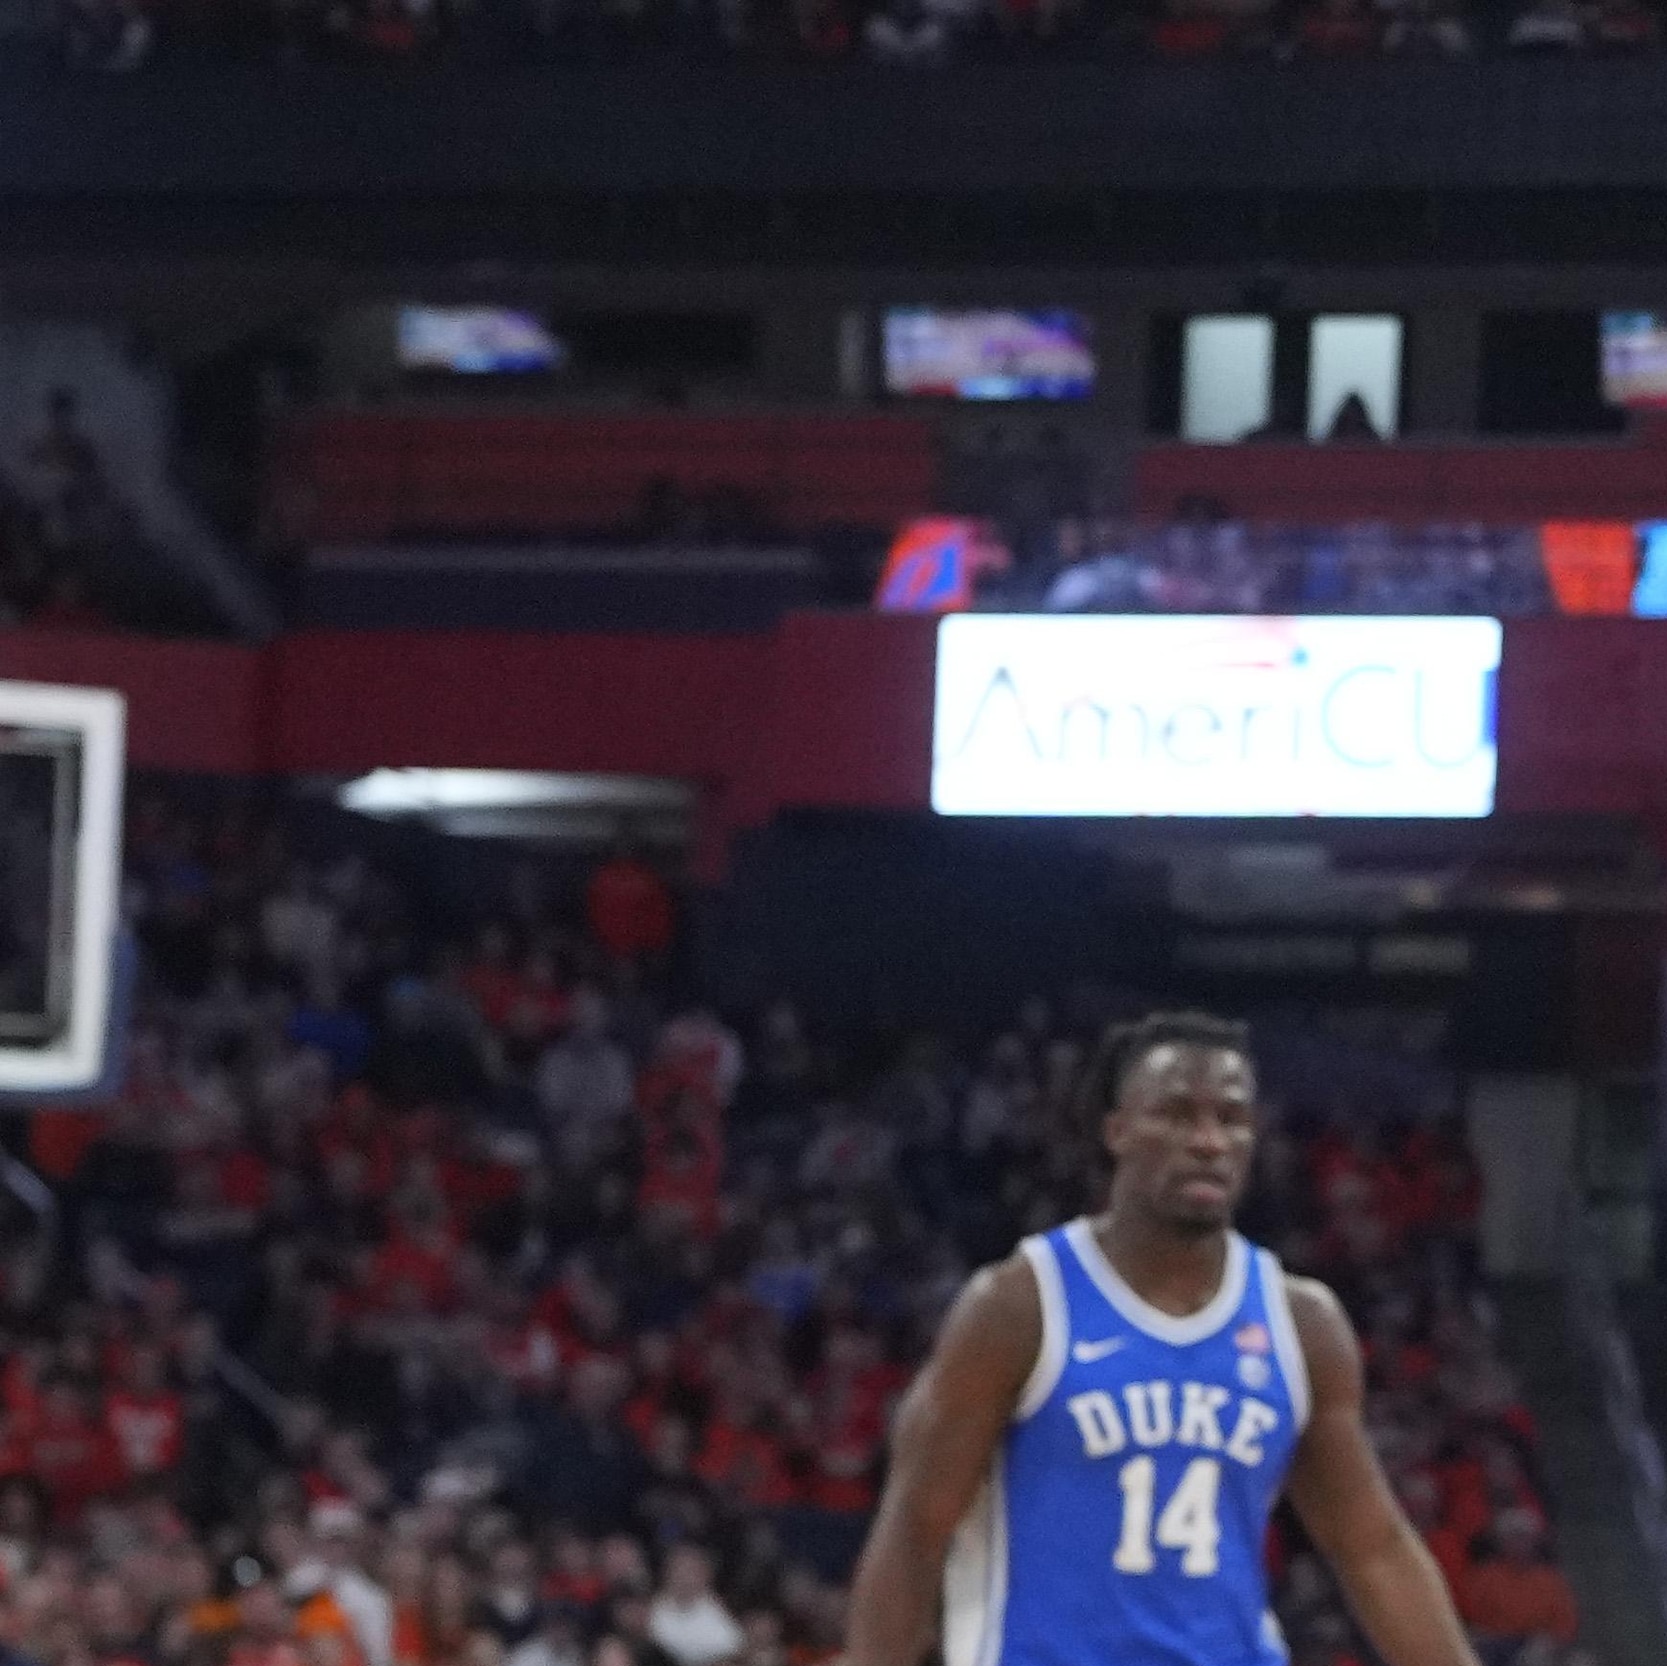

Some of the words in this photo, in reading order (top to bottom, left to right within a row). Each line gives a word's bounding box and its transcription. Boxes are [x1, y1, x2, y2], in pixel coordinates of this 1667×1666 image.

[956, 655, 1484, 769] AmeriCU
[1066, 1380, 1279, 1468] DUKE
[1113, 1454, 1222, 1577] 14
